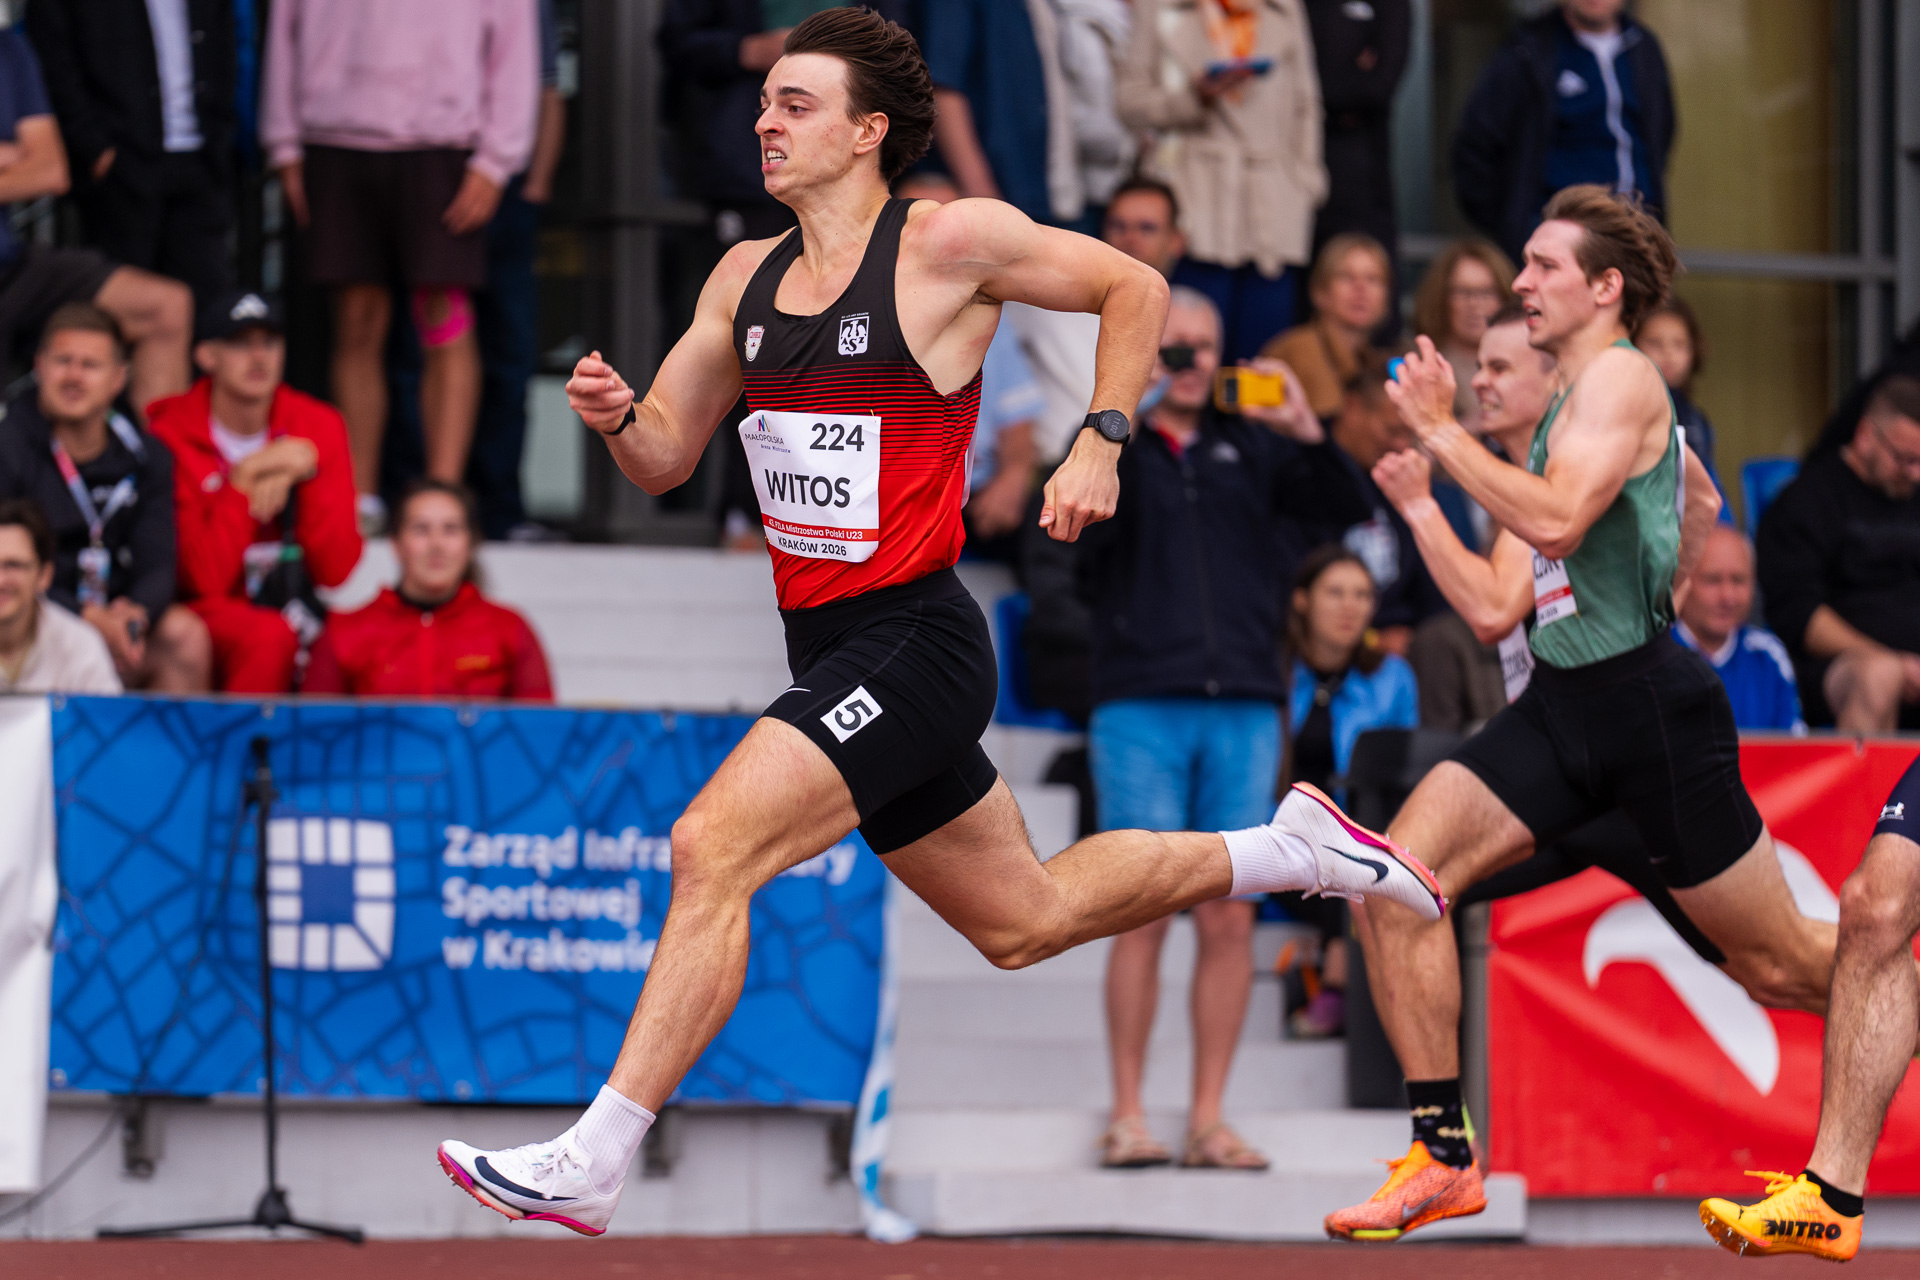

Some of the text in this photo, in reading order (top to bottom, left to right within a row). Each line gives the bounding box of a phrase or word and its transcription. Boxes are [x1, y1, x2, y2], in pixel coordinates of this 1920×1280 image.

[744, 433, 785, 445] MAŁOPOLSKA
[809, 422, 865, 452] 224
[764, 468, 851, 509] WITOS
[778, 535, 847, 556] KRAKÓW 2026
[785, 523, 824, 537] Mistrzostwa
[824, 528, 845, 539] Polski
[845, 531, 863, 540] U23
[834, 698, 874, 731] 5
[442, 824, 579, 879] Zarząd
[442, 876, 641, 930] Sportowej
[441, 936, 478, 970] w
[1762, 1219, 1842, 1240] NITRO
